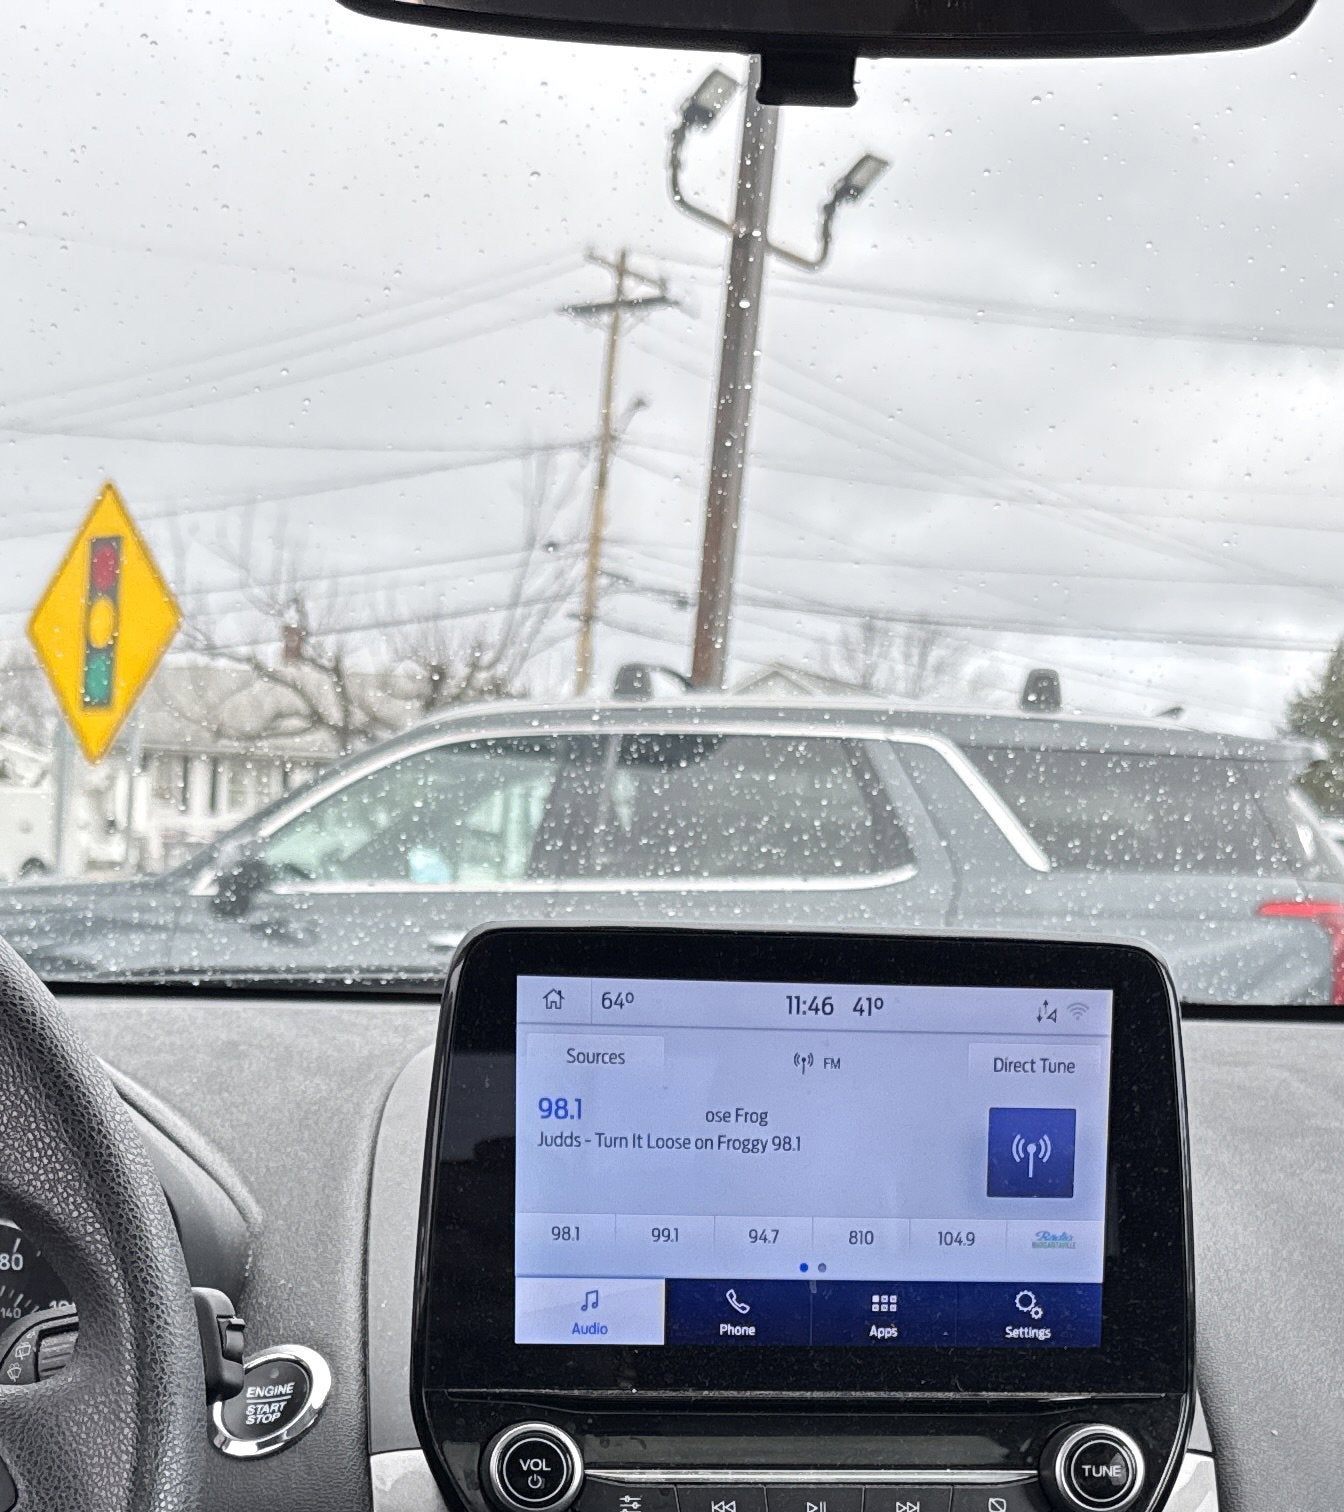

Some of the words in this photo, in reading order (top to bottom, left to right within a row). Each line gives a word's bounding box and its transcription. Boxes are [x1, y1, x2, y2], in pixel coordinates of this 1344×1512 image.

[786, 995, 835, 1016] 11:46
[566, 1048, 626, 1065] Sources
[823, 1057, 842, 1070] FM
[993, 1057, 1036, 1073] Direct
[1040, 1057, 1076, 1074] Tune
[538, 1097, 582, 1120] 98.1
[705, 1109, 731, 1123] ose
[735, 1107, 769, 1126] Frog
[537, 1131, 582, 1148] Judds
[594, 1132, 628, 1149] Turn
[632, 1133, 644, 1149] It
[647, 1133, 692, 1150] Loose
[694, 1137, 715, 1151] on
[717, 1135, 769, 1154] Froggy
[771, 1135, 802, 1152] 98.1
[551, 1226, 581, 1241] 98.1
[651, 1227, 679, 1243] 99.1
[748, 1229, 780, 1244] 94.7
[848, 1230, 875, 1246] 810
[937, 1231, 976, 1247] 104.9
[0, 1306, 22, 1319] 140
[572, 1322, 609, 1336] Audio
[719, 1323, 756, 1337] Phone
[869, 1324, 898, 1339] Apps
[1005, 1325, 1052, 1341] Settings
[246, 1382, 296, 1398] ENGINE
[245, 1401, 288, 1416] START
[245, 1412, 282, 1426] STOP
[519, 1458, 552, 1472] VOL
[1081, 1464, 1123, 1478] TUNE
